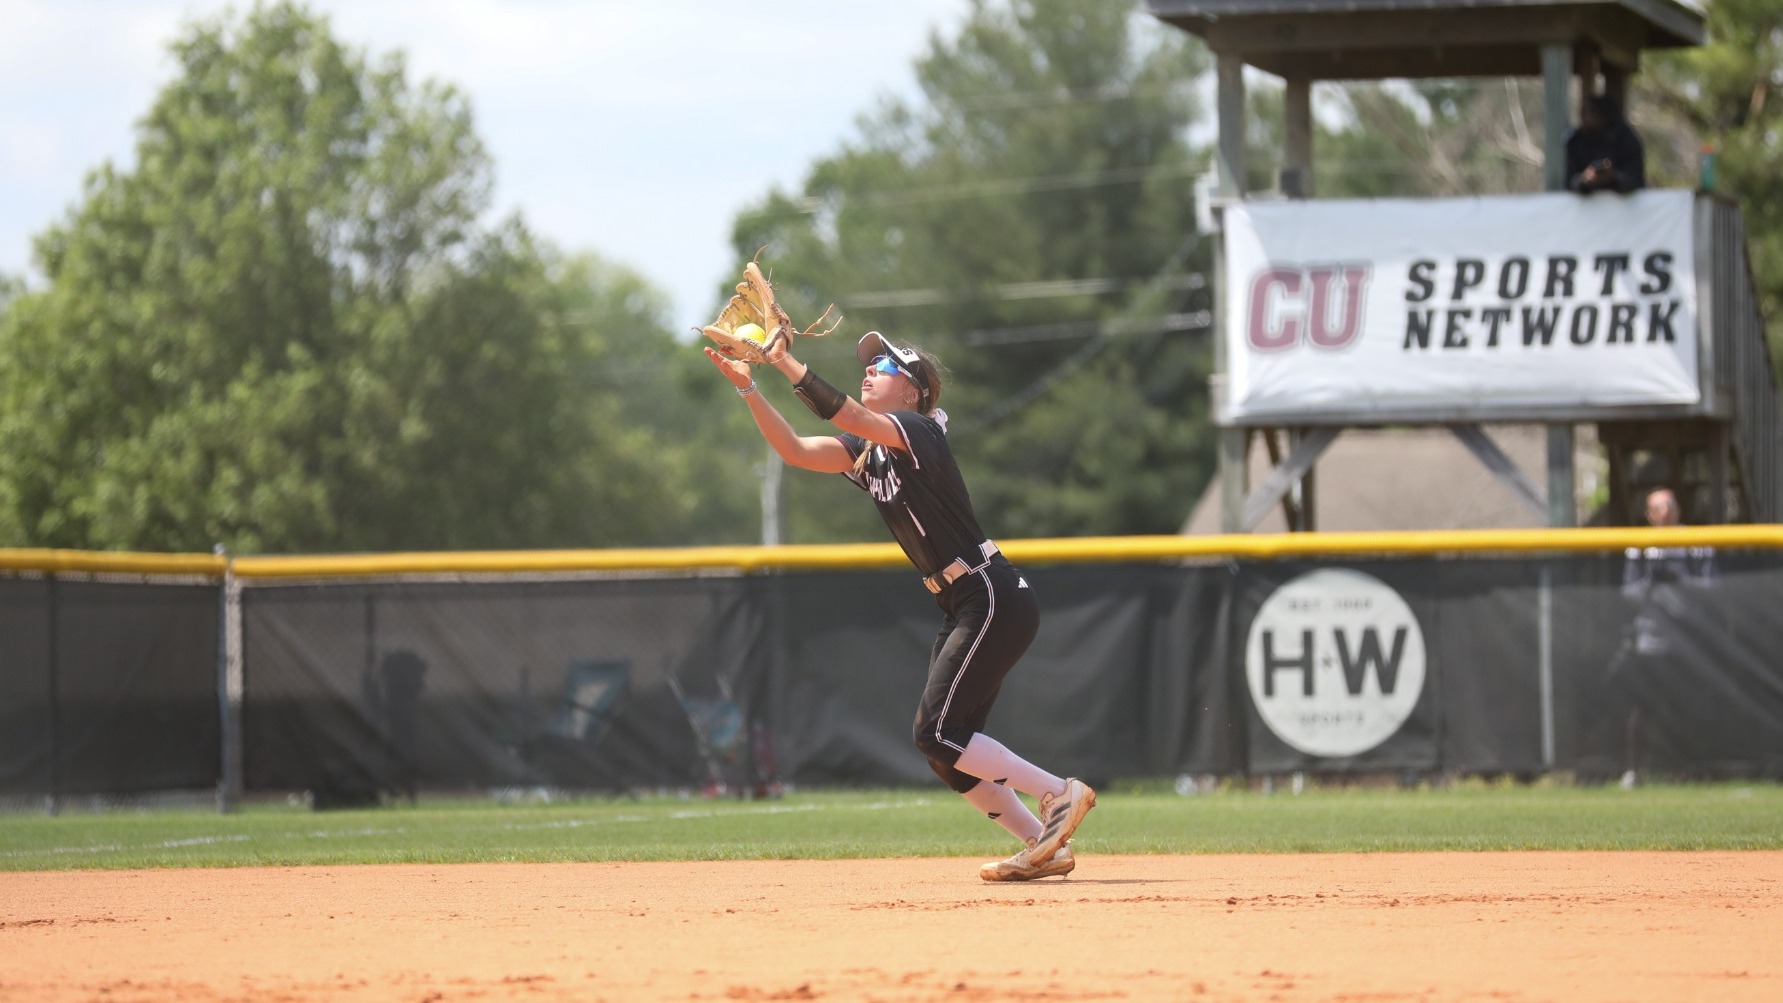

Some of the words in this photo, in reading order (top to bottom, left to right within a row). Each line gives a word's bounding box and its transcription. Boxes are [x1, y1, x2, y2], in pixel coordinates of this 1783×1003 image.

[1405, 251, 1675, 303] SPORTS
[1246, 263, 1372, 350] CU
[1403, 302, 1681, 349] NETWORK
